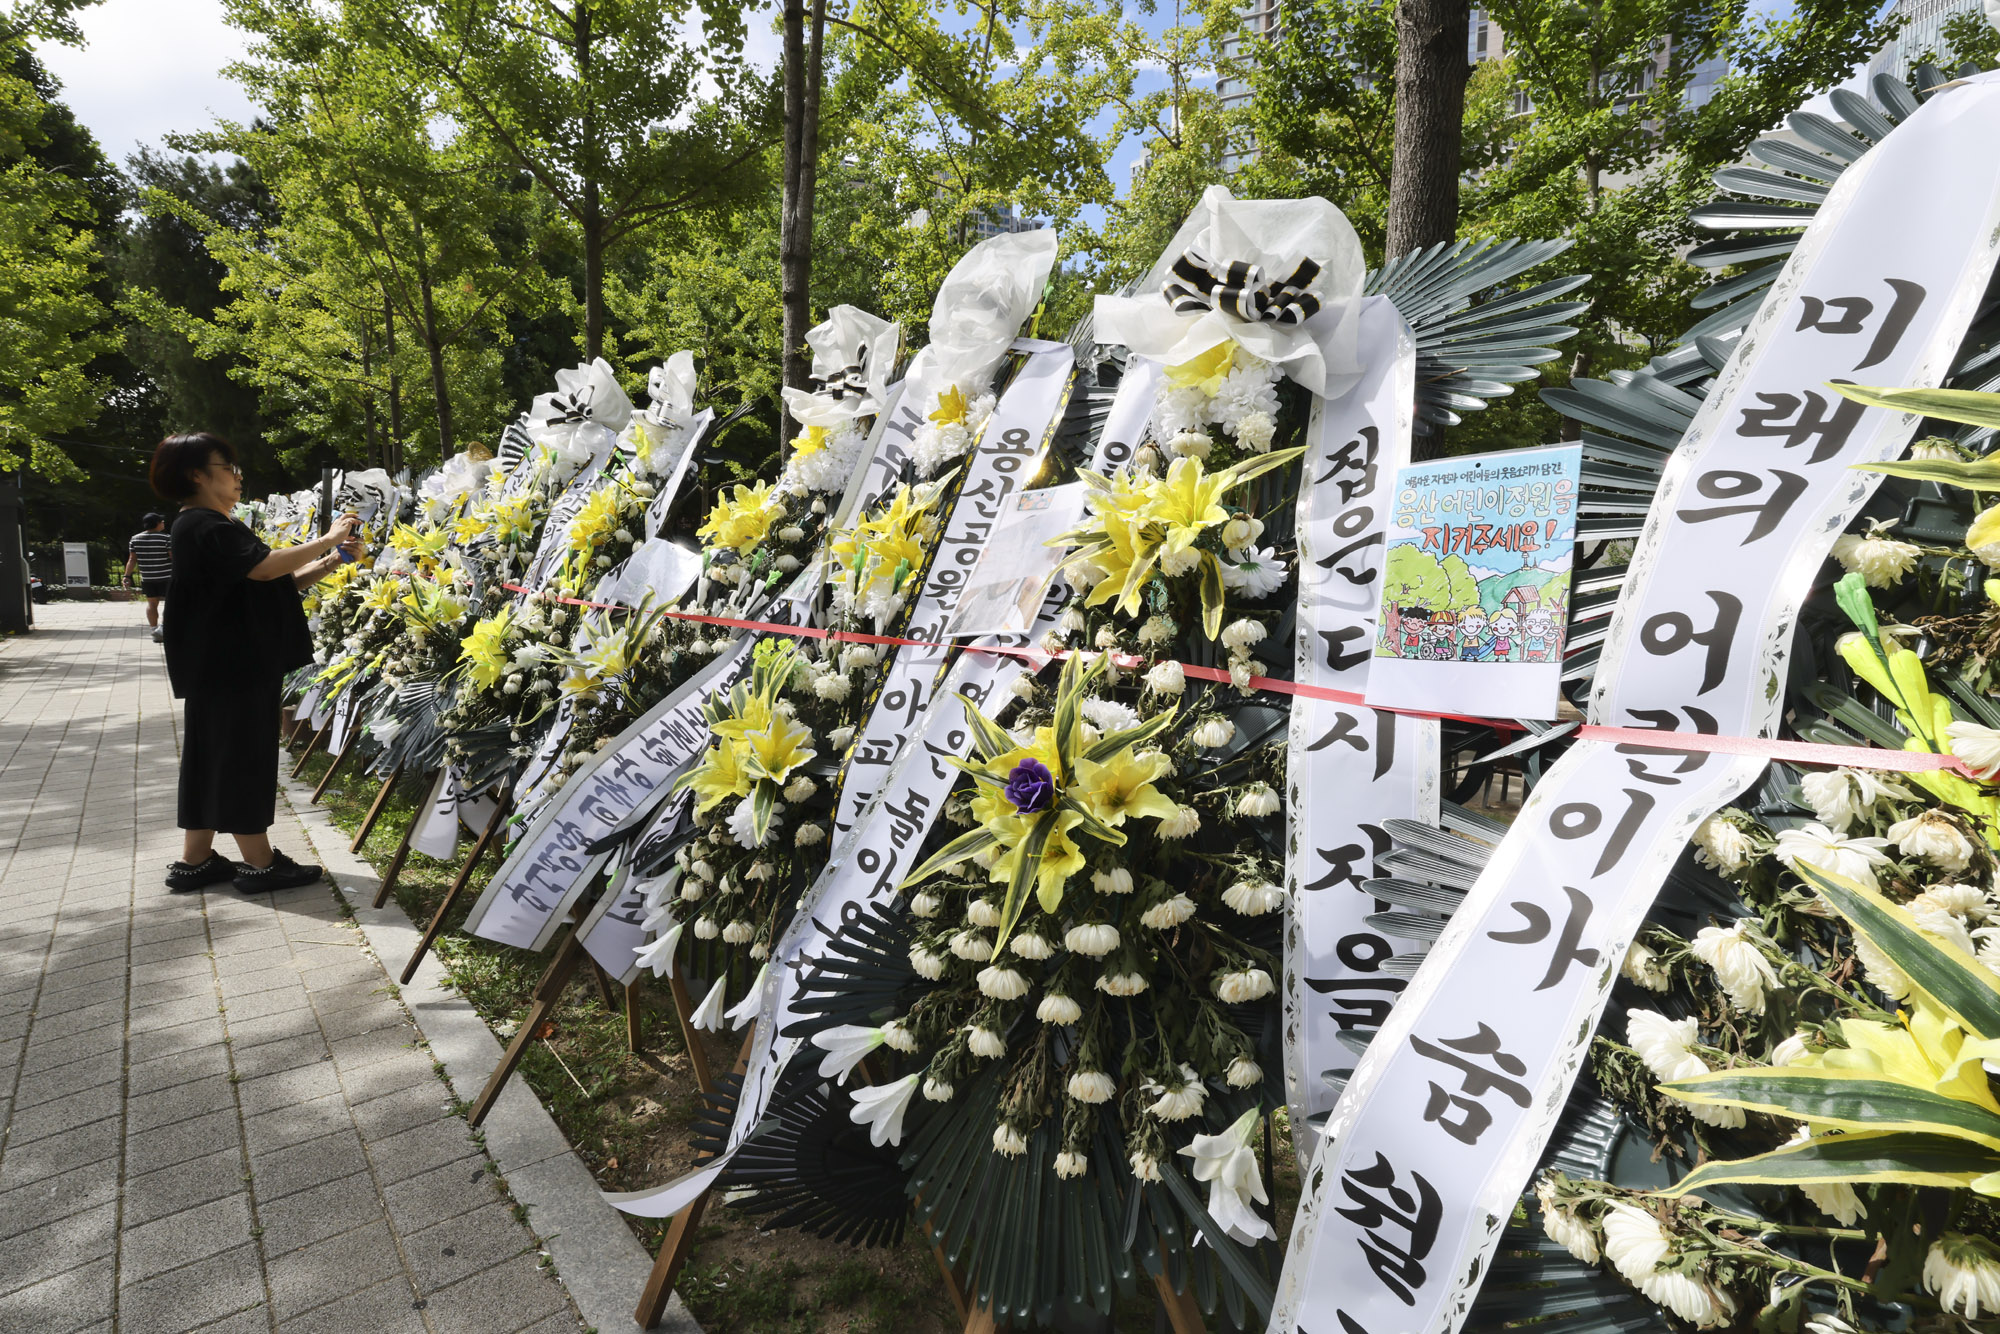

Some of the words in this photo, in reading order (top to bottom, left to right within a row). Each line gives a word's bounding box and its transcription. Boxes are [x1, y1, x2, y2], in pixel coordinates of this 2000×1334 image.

[1460, 469, 1500, 483] 어린이들의
[1541, 462, 1563, 476] 담긴
[1677, 277, 1927, 546] 미래의
[905, 427, 1035, 660] 용산공원에
[1487, 590, 1744, 992] 어린이가
